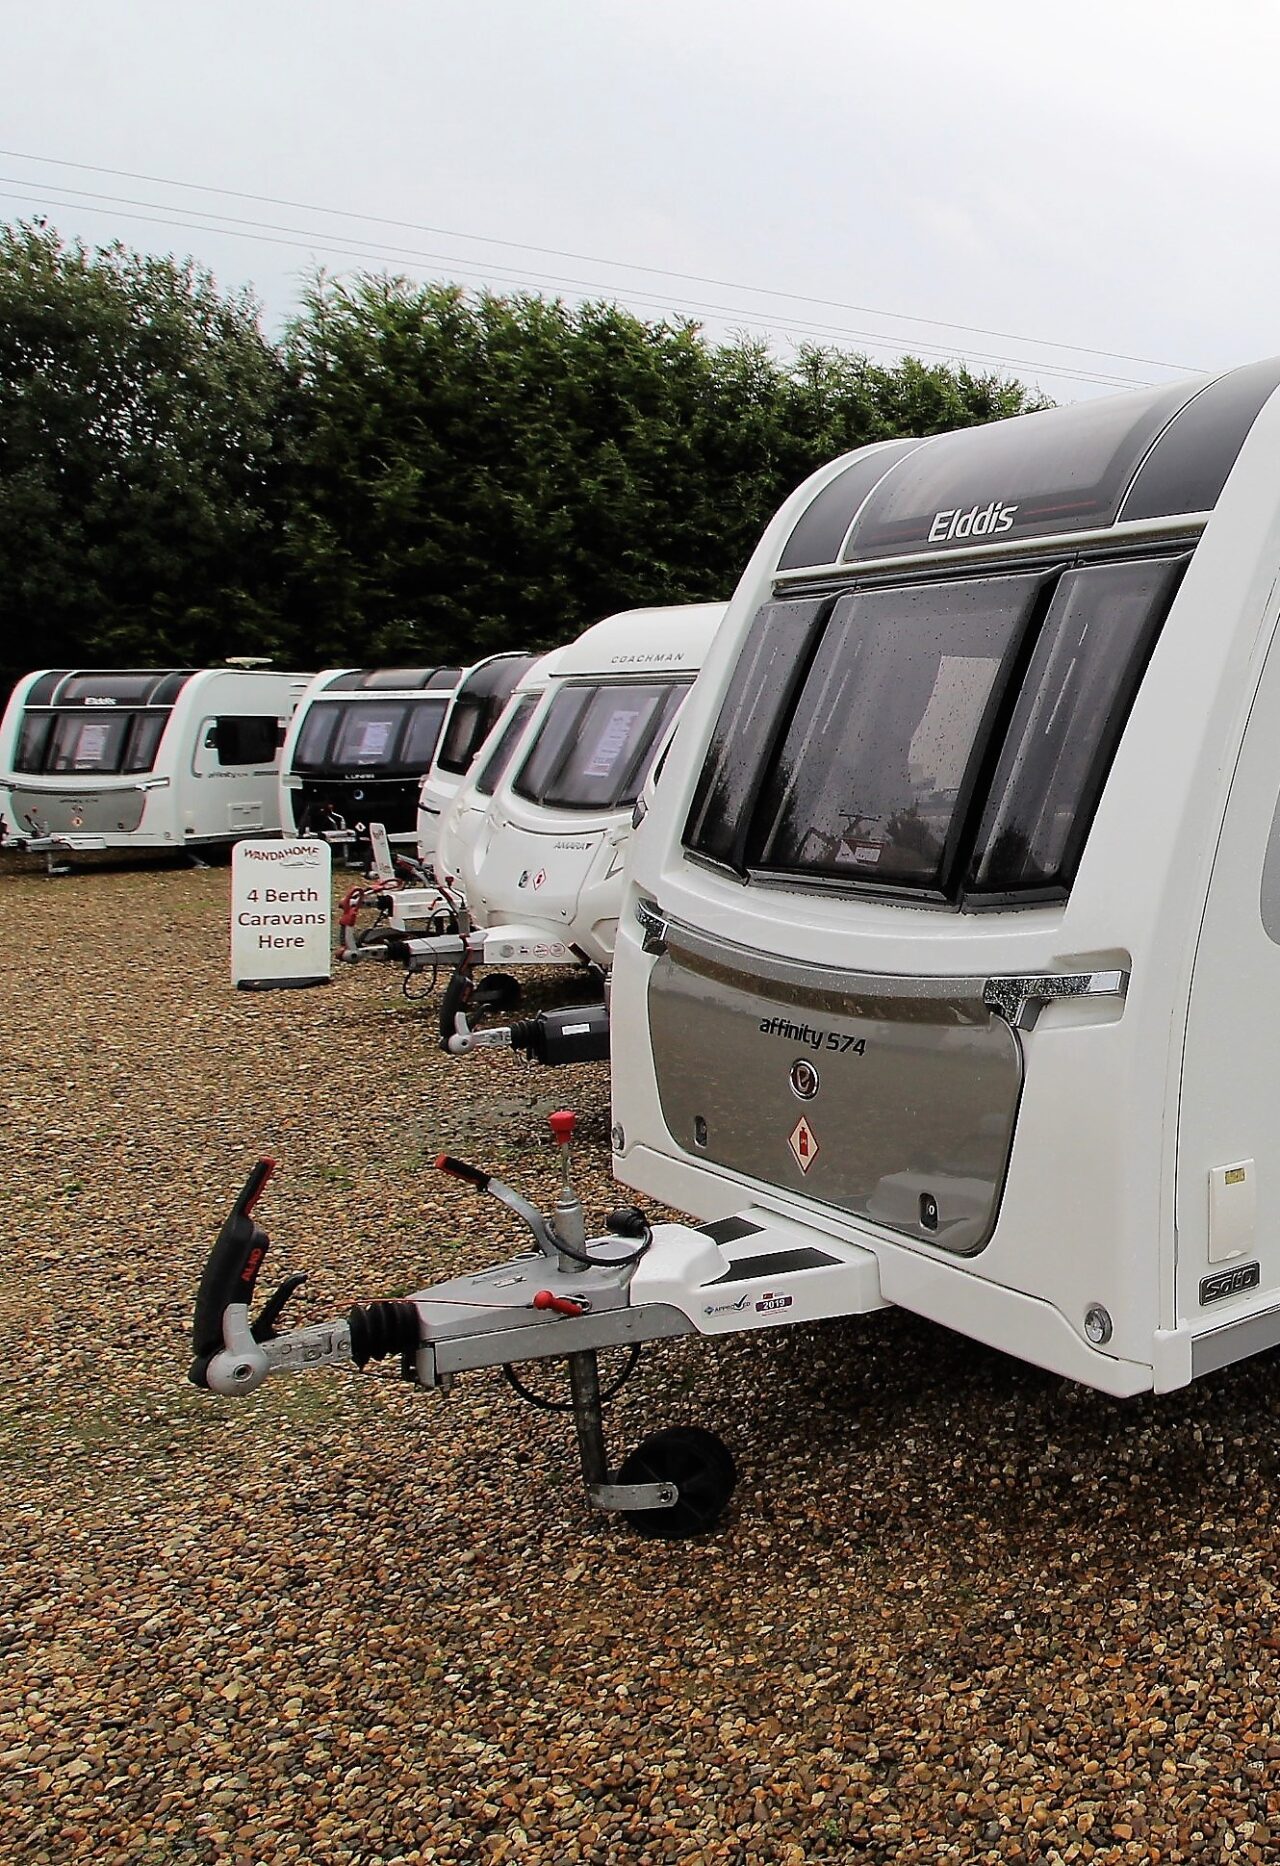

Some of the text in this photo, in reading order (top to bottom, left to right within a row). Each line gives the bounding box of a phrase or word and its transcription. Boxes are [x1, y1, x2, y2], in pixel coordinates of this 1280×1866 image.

[928, 502, 1019, 542] Elddis
[611, 653, 685, 664] COACHMAN
[244, 846, 320, 860] WANDAHOME
[247, 888, 318, 902] 4 Berth
[238, 912, 326, 926] Caravans
[259, 935, 305, 949] Here
[759, 1017, 867, 1056] affinity 574
[763, 1298, 786, 1310] 2019
